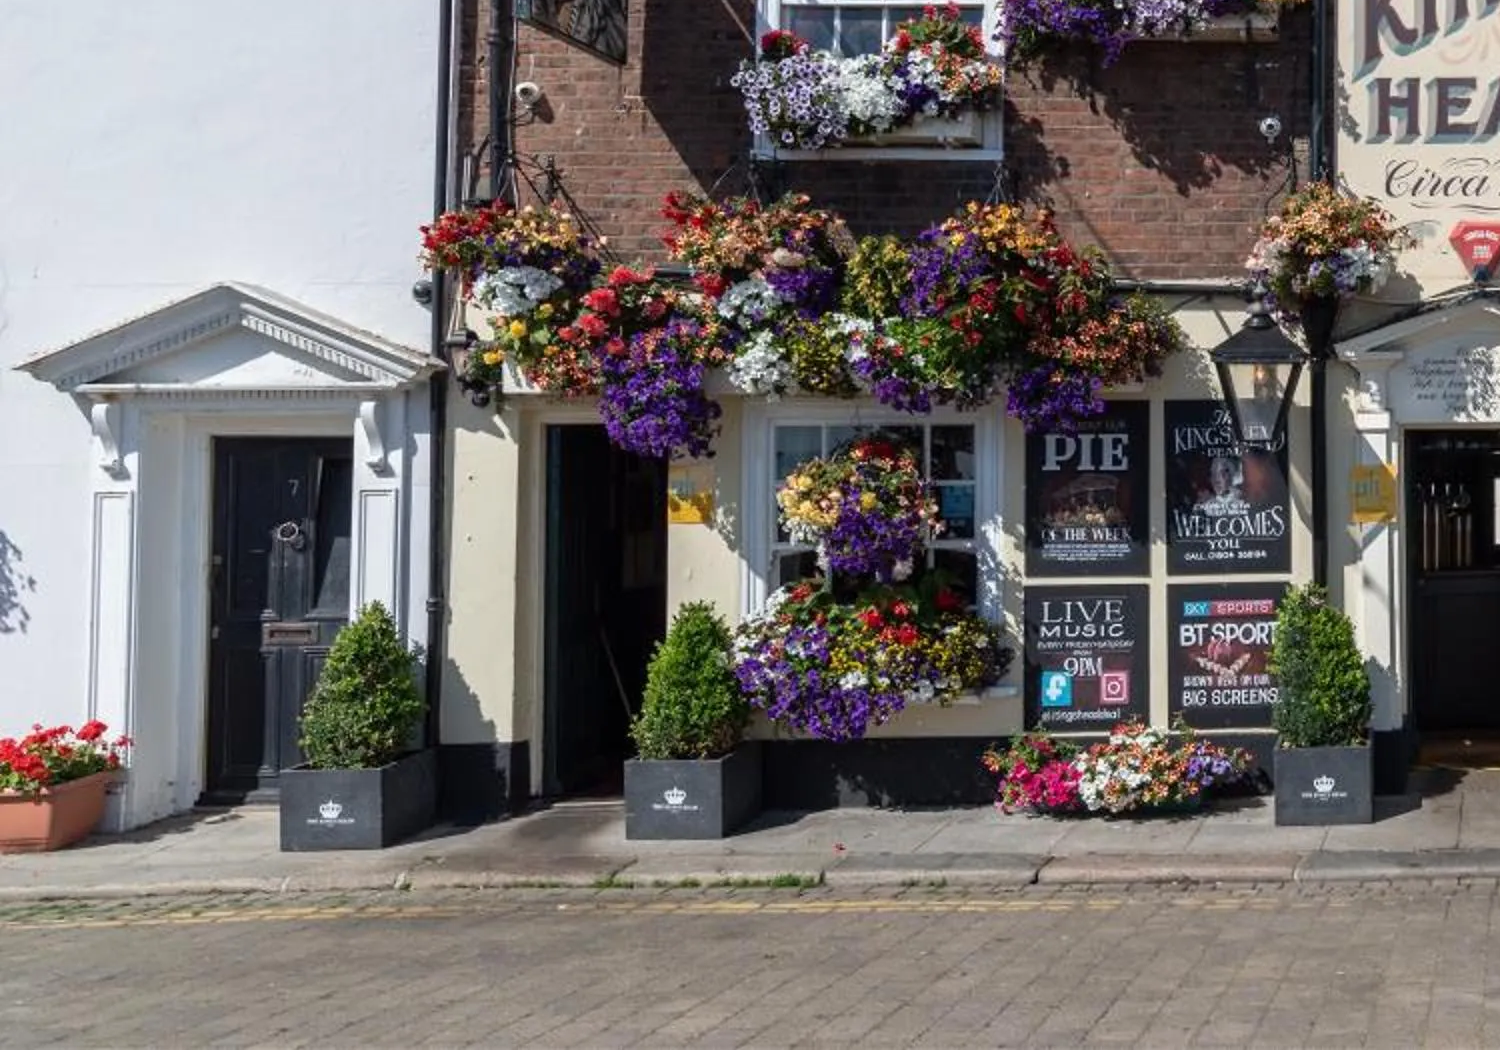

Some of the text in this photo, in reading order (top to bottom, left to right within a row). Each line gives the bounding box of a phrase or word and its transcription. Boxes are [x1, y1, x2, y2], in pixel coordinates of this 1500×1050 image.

[1385, 159, 1490, 198] Circa
[1214, 409, 1233, 425] Th
[1042, 433, 1129, 471] PIE
[289, 480, 299, 496] 7
[1173, 505, 1285, 538] WELCOMES
[1064, 527, 1088, 542] THE
[1207, 538, 1241, 550] YOU
[1184, 551, 1205, 561] CALL
[1041, 599, 1125, 623] LIVE
[1184, 601, 1270, 615] SKY SPORTS
[1040, 623, 1125, 638] MUSIC
[1180, 621, 1280, 647] BT SPORT
[1063, 657, 1103, 677] 9PM
[1183, 687, 1279, 706] BIG SCREENS
